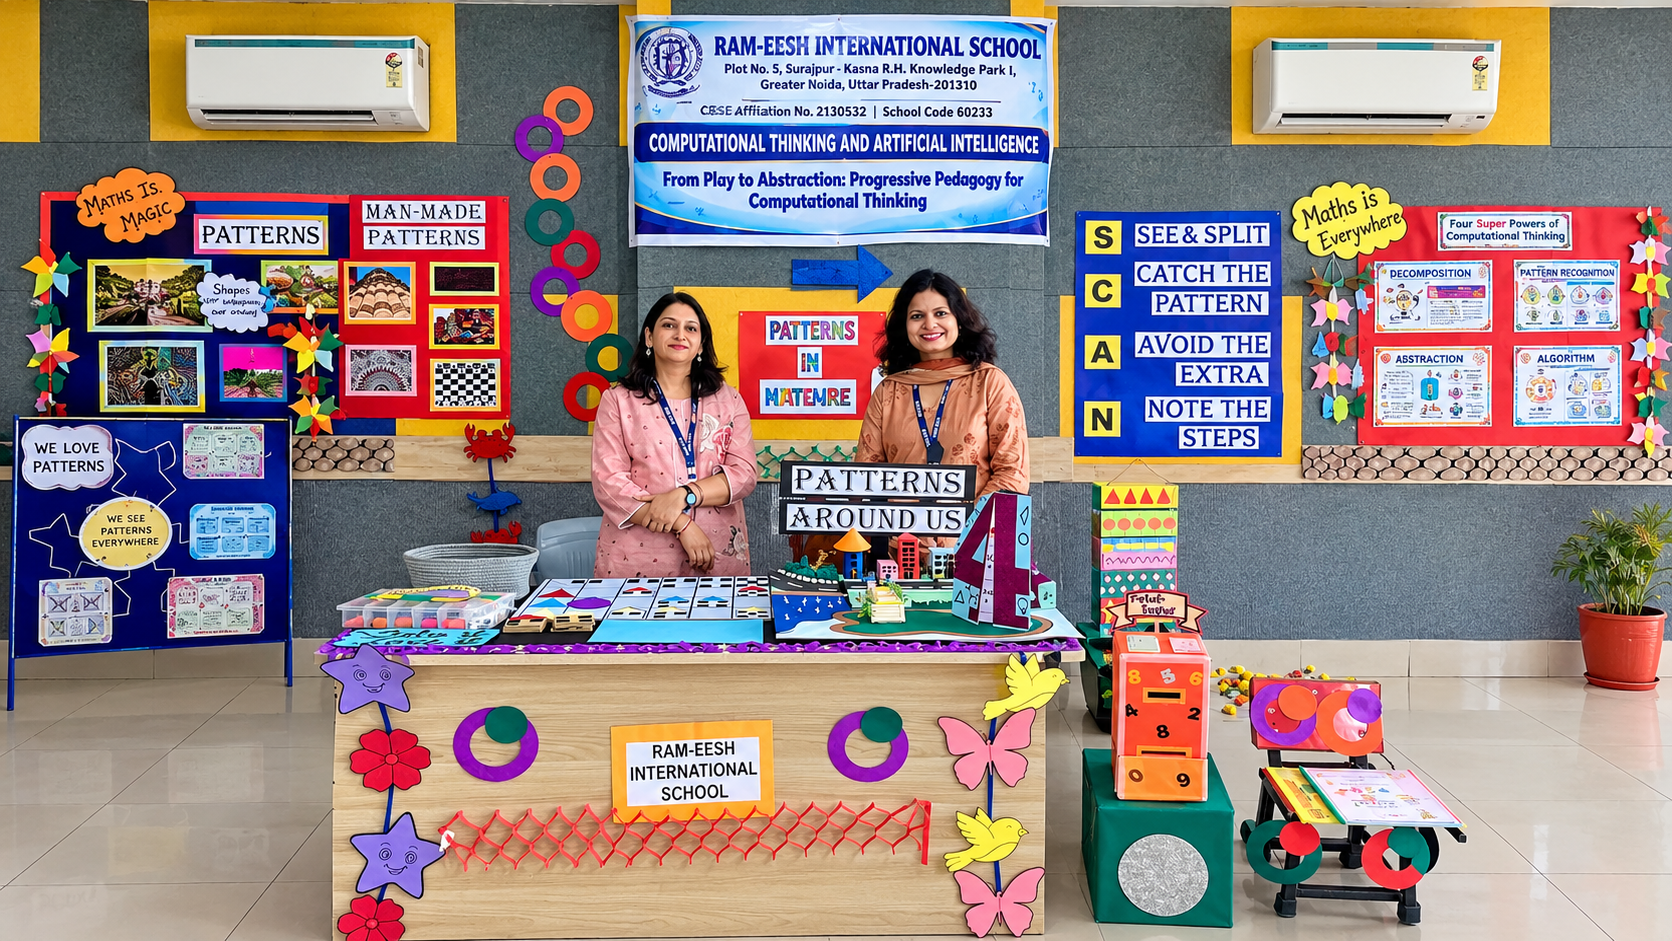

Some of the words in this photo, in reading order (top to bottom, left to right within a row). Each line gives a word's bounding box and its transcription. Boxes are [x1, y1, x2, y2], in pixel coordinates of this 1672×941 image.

[714, 36, 810, 57] RAM-EESH
[815, 36, 965, 58] INTERNATIONAL
[969, 38, 1042, 60] SCHOOL
[724, 64, 748, 74] Plot
[750, 64, 769, 74] No.
[772, 64, 783, 76] 5,
[786, 63, 835, 76] Surajpur
[844, 64, 879, 74] Kasna
[882, 64, 906, 74] R.H.
[910, 63, 975, 77] Knowledge
[979, 64, 1006, 76] Park
[760, 79, 805, 90] Greater
[808, 79, 845, 91] Noida,
[848, 79, 879, 90] Uttar
[882, 79, 977, 90] Pradesh-201310
[794, 106, 813, 117] No.
[816, 106, 866, 117] 2130532
[883, 106, 921, 117] School
[924, 106, 954, 118] Code
[957, 107, 993, 118] 60233
[649, 133, 766, 154] COMPUTATIONAL
[769, 133, 837, 153] THINKING
[840, 134, 869, 153] AND
[873, 133, 947, 153] ARTIFICIAL
[950, 133, 1039, 155] INTELLIGENCE
[663, 171, 700, 187] From
[703, 171, 735, 191] Play
[738, 173, 754, 187] to
[757, 171, 846, 188] Abstraction:
[850, 171, 931, 192] Progressive
[935, 171, 1001, 191] Pedagogy
[1004, 172, 1024, 187] for
[83, 189, 134, 217] MATHS
[366, 202, 482, 221] MAN-MADE
[748, 192, 860, 211] Computational
[863, 192, 927, 212] Thinking
[1301, 198, 1357, 231] Maths
[1361, 191, 1379, 211] is
[120, 202, 172, 234] MAGIC
[1450, 219, 1473, 229] Four
[1476, 219, 1507, 232] Super
[1510, 219, 1546, 229] Powers
[1548, 218, 1560, 229] of
[202, 224, 320, 246] PATTERNS
[368, 228, 481, 247] PATTERNS
[1094, 225, 1114, 249] S
[1137, 225, 1178, 244] SEE
[1182, 225, 1198, 244] &
[1204, 225, 1267, 244] SPLIT
[1317, 210, 1402, 251] Everywhere
[1446, 231, 1520, 243] Computational
[1522, 231, 1565, 243] Thinking
[1137, 264, 1215, 283] CATCH
[1223, 264, 1268, 282] THE
[1390, 269, 1471, 278] DECOMPOSITION
[1520, 269, 1558, 277] PATTERN
[213, 283, 250, 298] Shapes
[1092, 279, 1113, 303] C
[1155, 294, 1262, 313] PATTERN
[769, 320, 855, 341] PATTERNS
[1091, 341, 1114, 363] A
[1138, 334, 1213, 354] AVOID
[1221, 336, 1268, 354] THE
[801, 353, 819, 373] IN
[1537, 354, 1595, 363] ALGORITHM
[1180, 365, 1263, 383] EXTRA
[1148, 400, 1213, 418] NOTE
[1221, 400, 1268, 418] THE
[1092, 408, 1112, 431] N
[1183, 429, 1256, 447] STEPS
[34, 442, 57, 454] WE
[63, 442, 100, 454] LOVE
[33, 460, 104, 473] PATTERNS
[795, 467, 961, 494] PATTERNS
[107, 515, 124, 523] WE
[127, 514, 145, 523] SEE
[790, 507, 915, 529] AROUND
[926, 509, 962, 531] US
[101, 526, 152, 535] PATTERNS
[92, 537, 159, 548] EVERYWHERE
[1128, 669, 1141, 684] 8
[1160, 668, 1176, 684] 5
[1189, 671, 1203, 686] 6
[1187, 707, 1201, 721] 2
[1156, 724, 1170, 738] 8
[652, 741, 735, 759] RAM-EESH
[630, 761, 758, 782] INTERNATIONAL
[661, 784, 729, 801] SCHOOL
